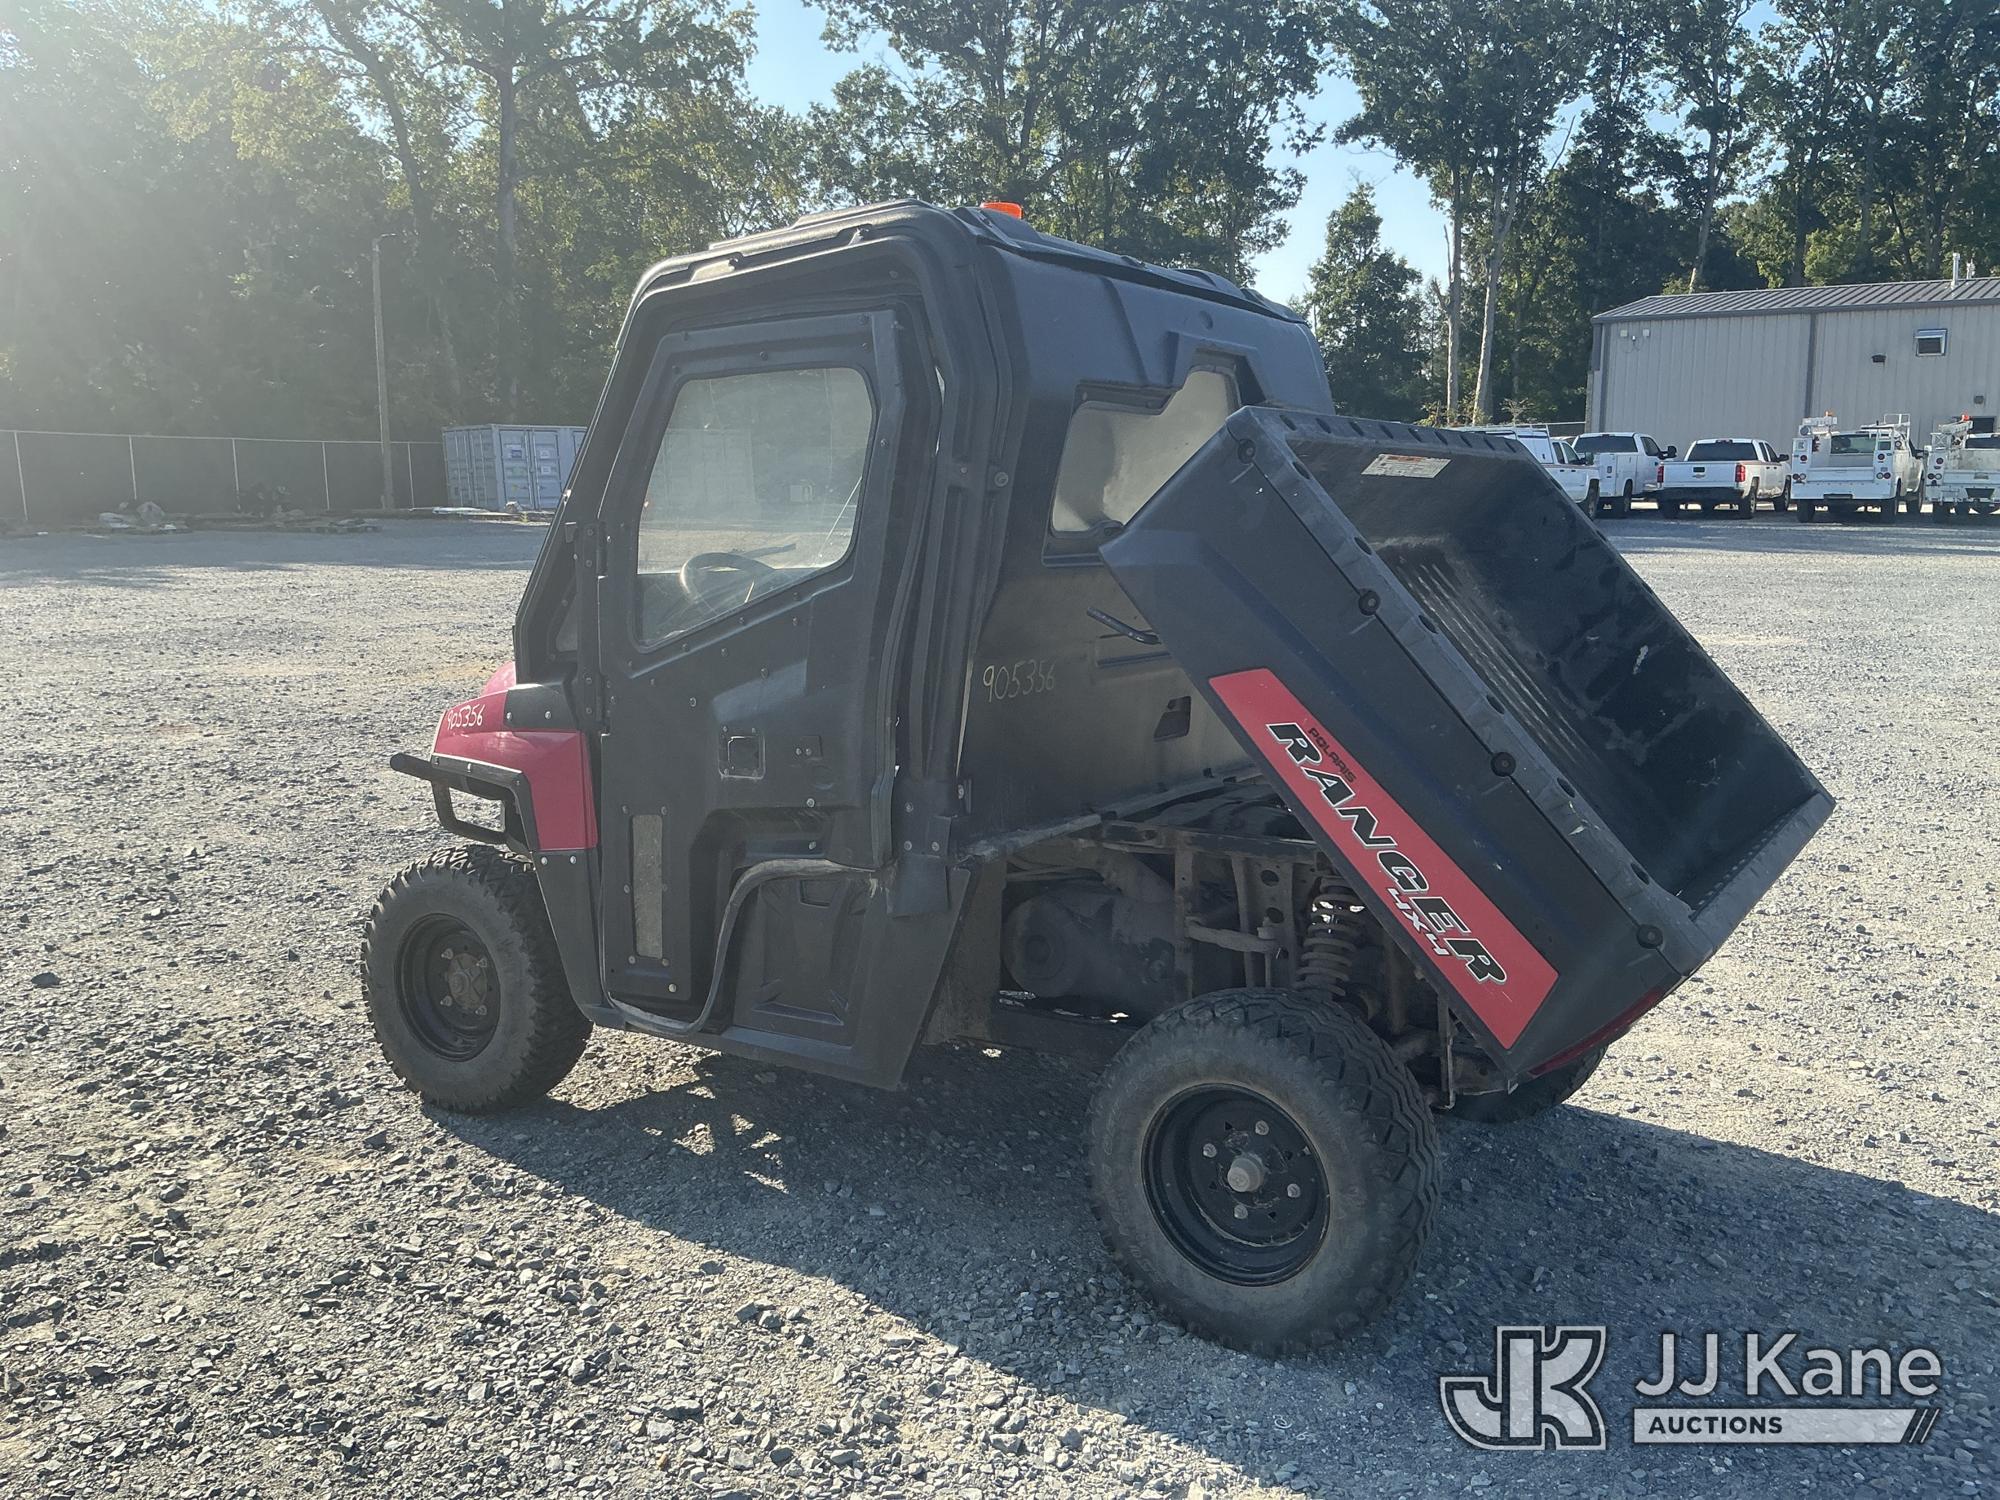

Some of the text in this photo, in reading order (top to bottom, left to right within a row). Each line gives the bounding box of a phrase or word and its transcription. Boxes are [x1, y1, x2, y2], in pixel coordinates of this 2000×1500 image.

[983, 659, 1056, 702] 905356
[447, 704, 485, 730] 905356
[1307, 728, 1356, 783] POLARIS
[1266, 723, 1506, 983] RANGER
